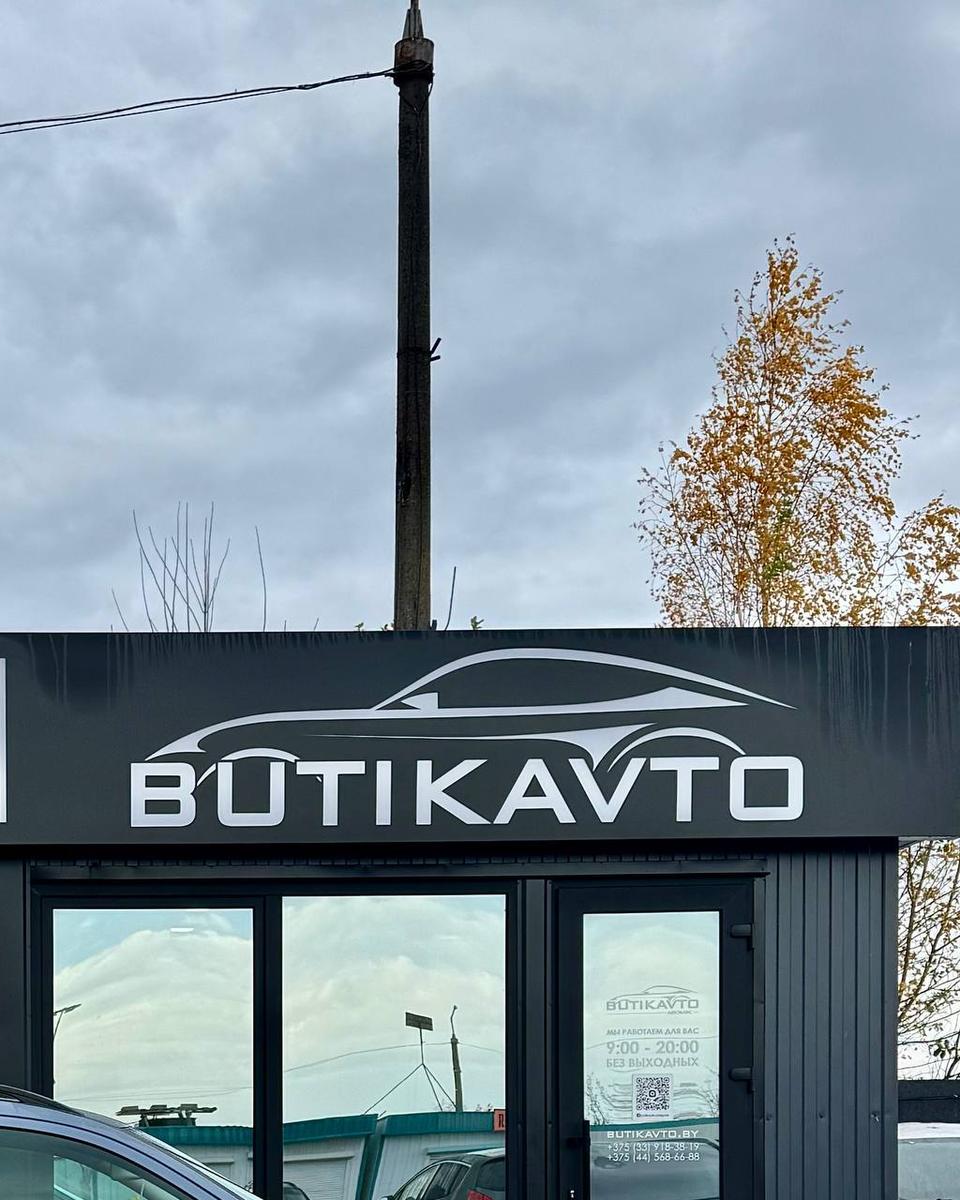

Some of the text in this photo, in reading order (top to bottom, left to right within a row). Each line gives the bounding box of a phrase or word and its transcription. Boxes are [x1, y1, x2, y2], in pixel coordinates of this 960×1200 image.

[130, 755, 805, 828] BUTIKAVTO
[606, 999, 699, 1011] BUTIKAVTO
[606, 1041, 639, 1054] 9:00
[655, 1040, 699, 1054] 20:00
[606, 1057, 699, 1068] БЕЗ ВЫХОДНЫХ
[607, 1130, 699, 1138] BUTIKAVTO.BY
[608, 1143, 700, 1153] +375 (33) 918-38-19
[608, 1152, 700, 1163] +375 (44) 568-66-88
